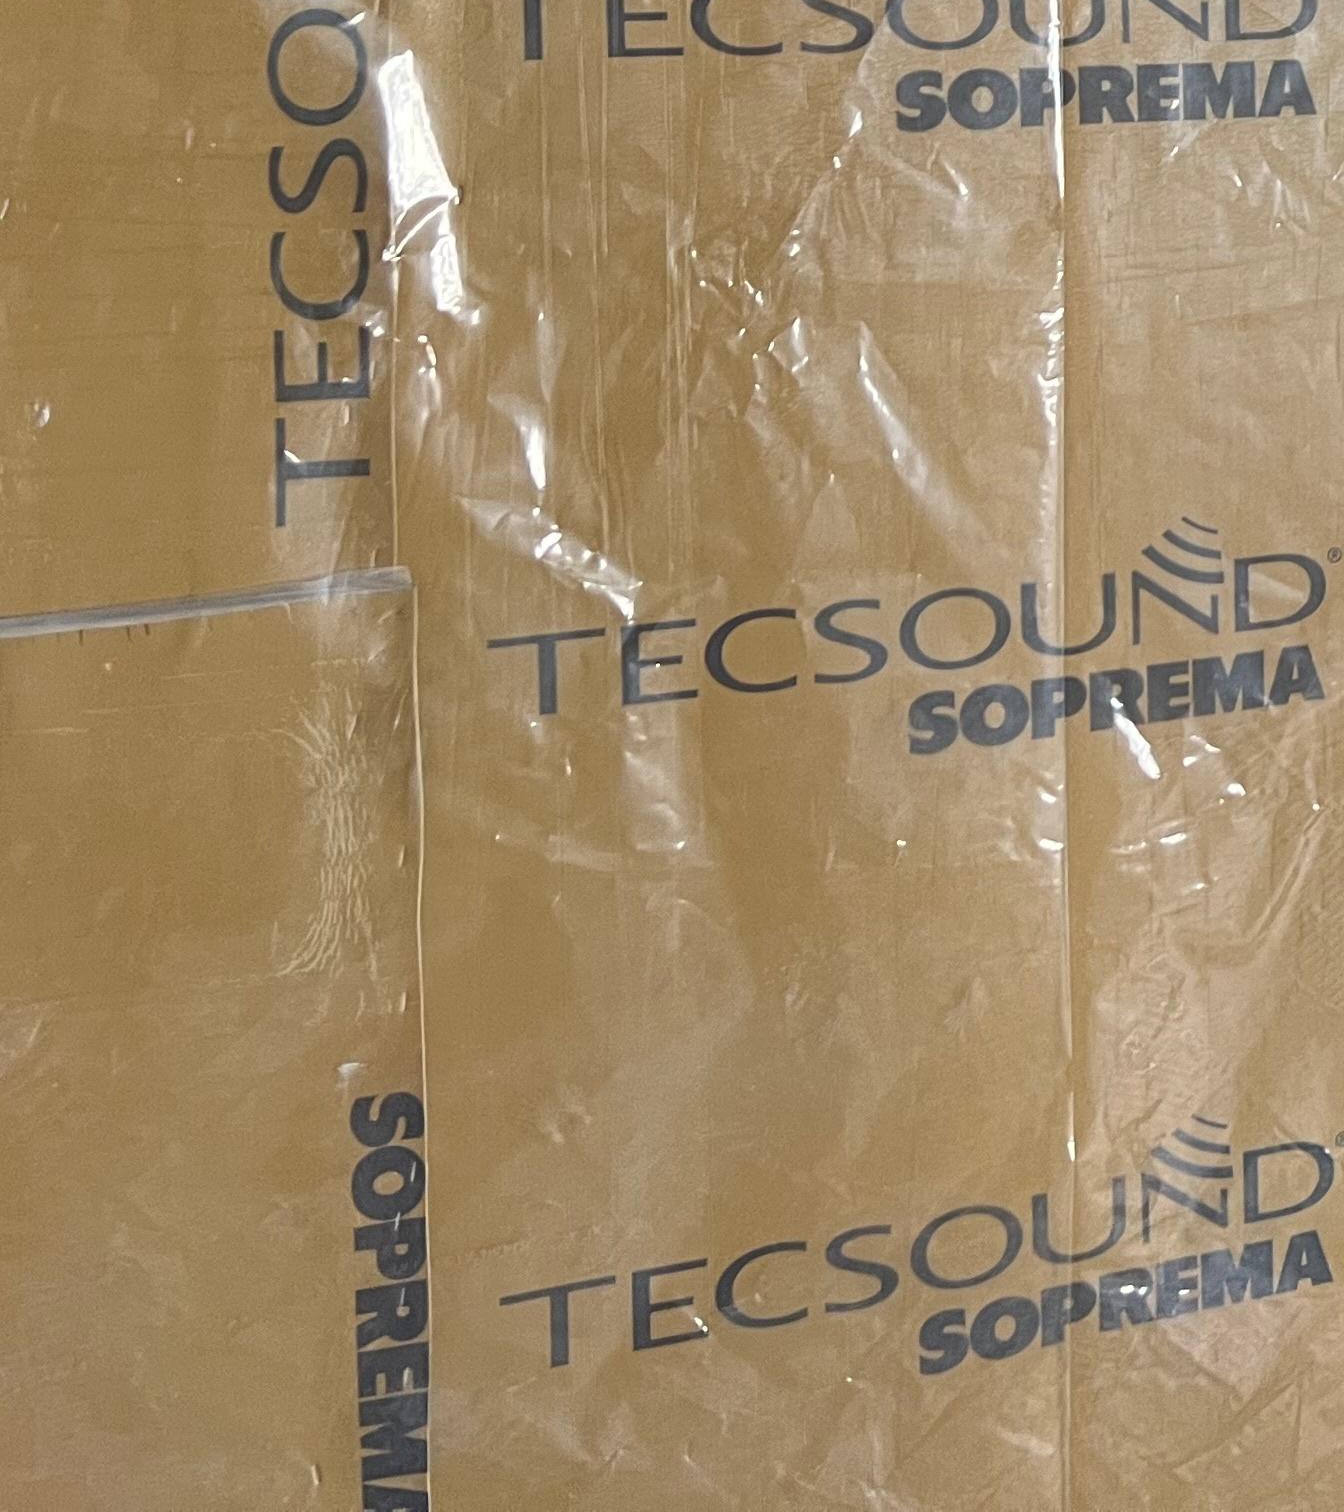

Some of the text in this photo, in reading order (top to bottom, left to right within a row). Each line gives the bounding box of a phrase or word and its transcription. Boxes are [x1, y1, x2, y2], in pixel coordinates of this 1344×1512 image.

[895, 59, 1317, 131] SOPREMA
[487, 545, 1327, 715] TECSOUND
[909, 644, 1325, 754] SOPREMA
[499, 1141, 1334, 1367] TECSOUND
[919, 1230, 1333, 1374] SOPREMA
